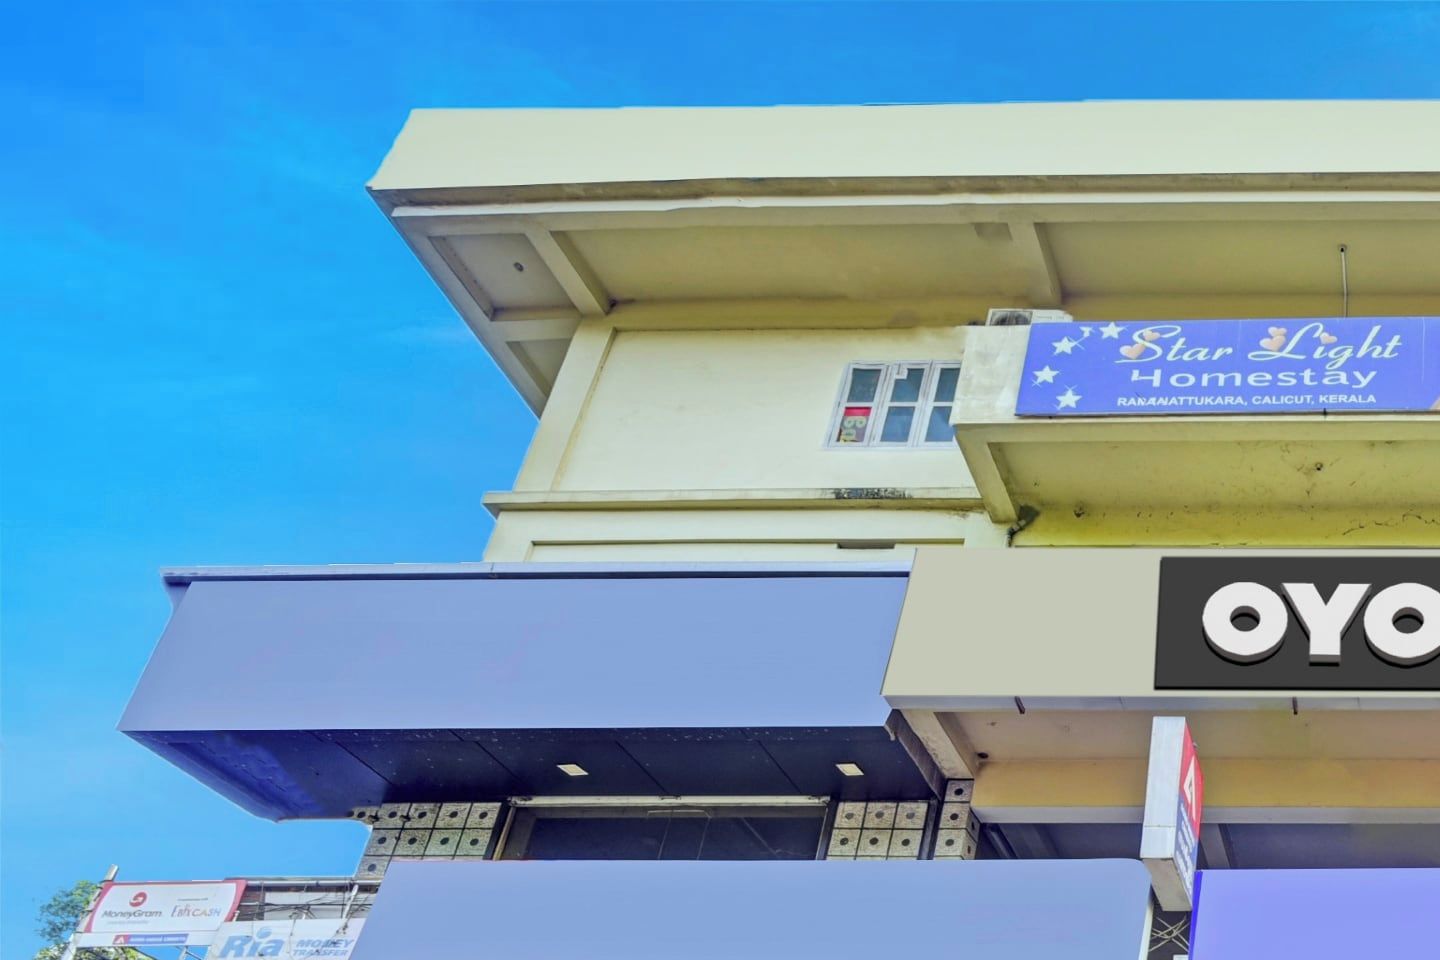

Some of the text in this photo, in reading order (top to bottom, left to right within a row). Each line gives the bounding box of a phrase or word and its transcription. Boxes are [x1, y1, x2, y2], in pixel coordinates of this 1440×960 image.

[1115, 322, 1402, 371] Star Light
[1131, 368, 1377, 388] Homestay
[1251, 394, 1315, 406] CALICUT,
[1318, 393, 1377, 404] KERALA
[102, 909, 163, 920] MoneyGram
[217, 926, 285, 959] Ria
